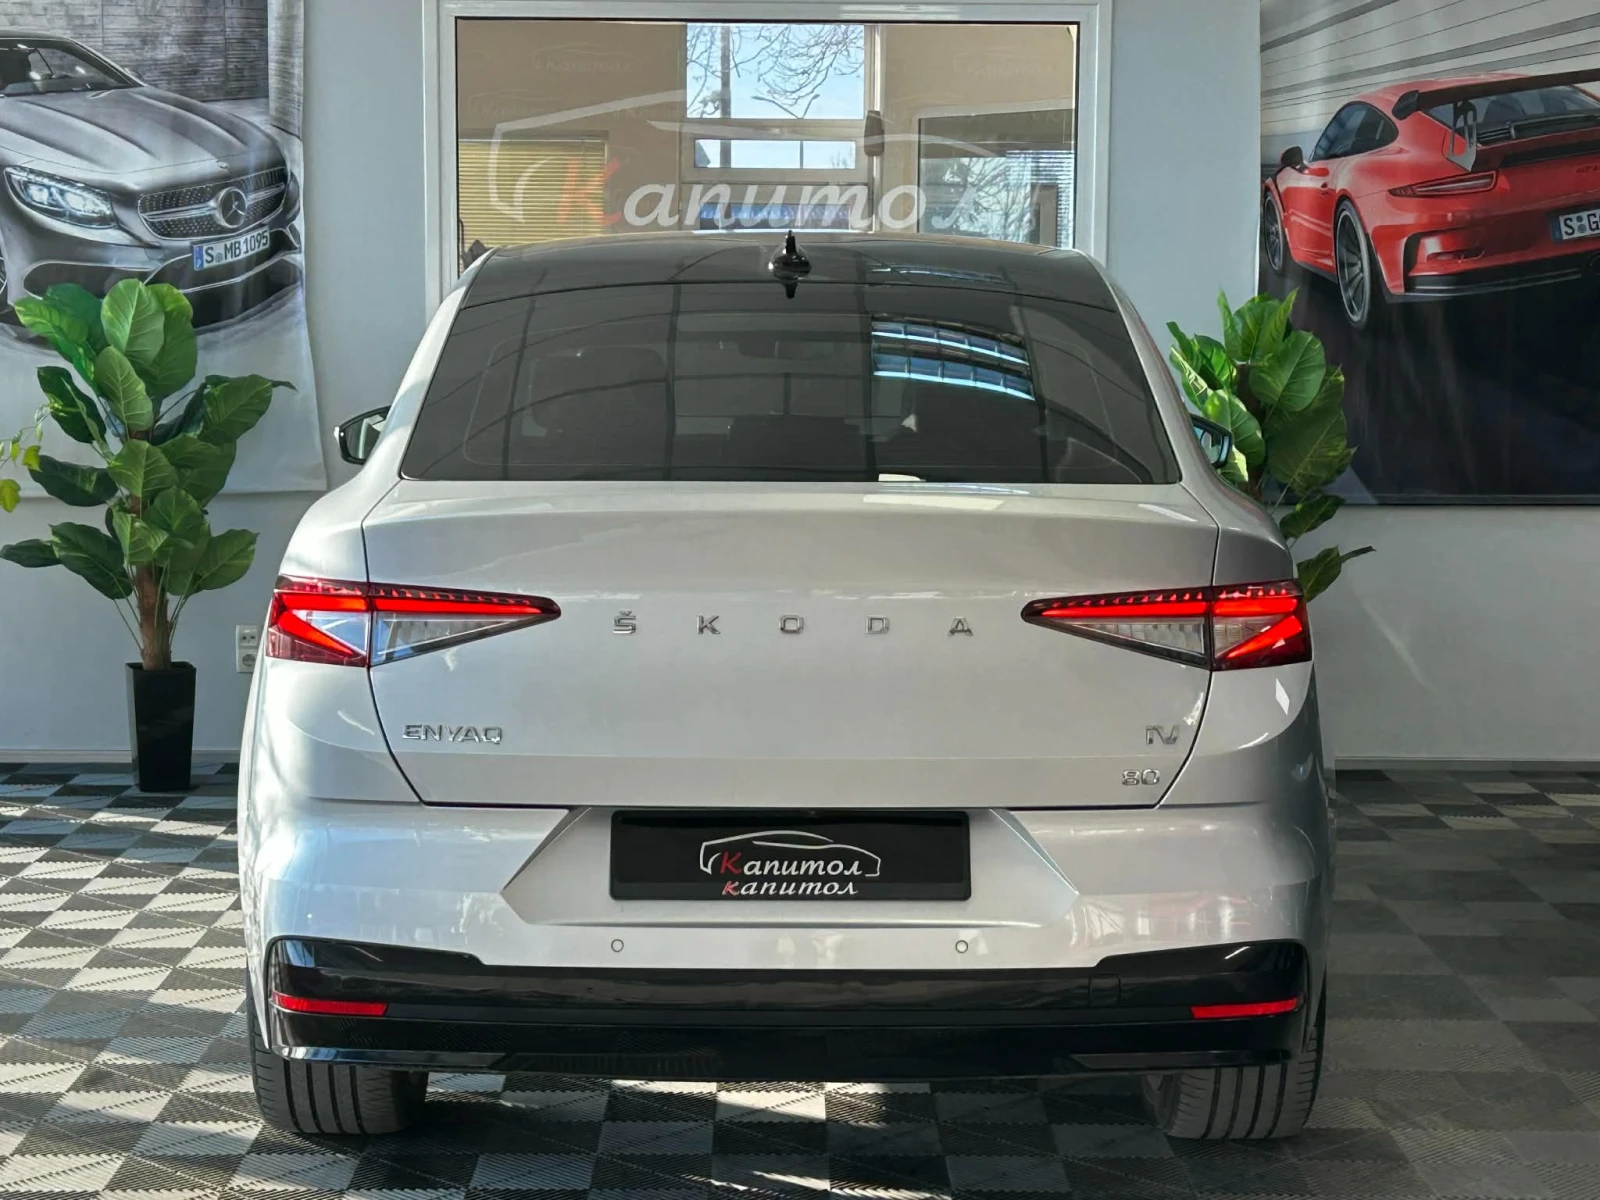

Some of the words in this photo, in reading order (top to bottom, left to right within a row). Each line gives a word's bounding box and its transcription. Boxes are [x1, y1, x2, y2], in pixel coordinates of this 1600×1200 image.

[402, 723, 503, 745] ENYAQ
[1122, 769, 1161, 786] 80
[719, 850, 863, 876] Капитол
